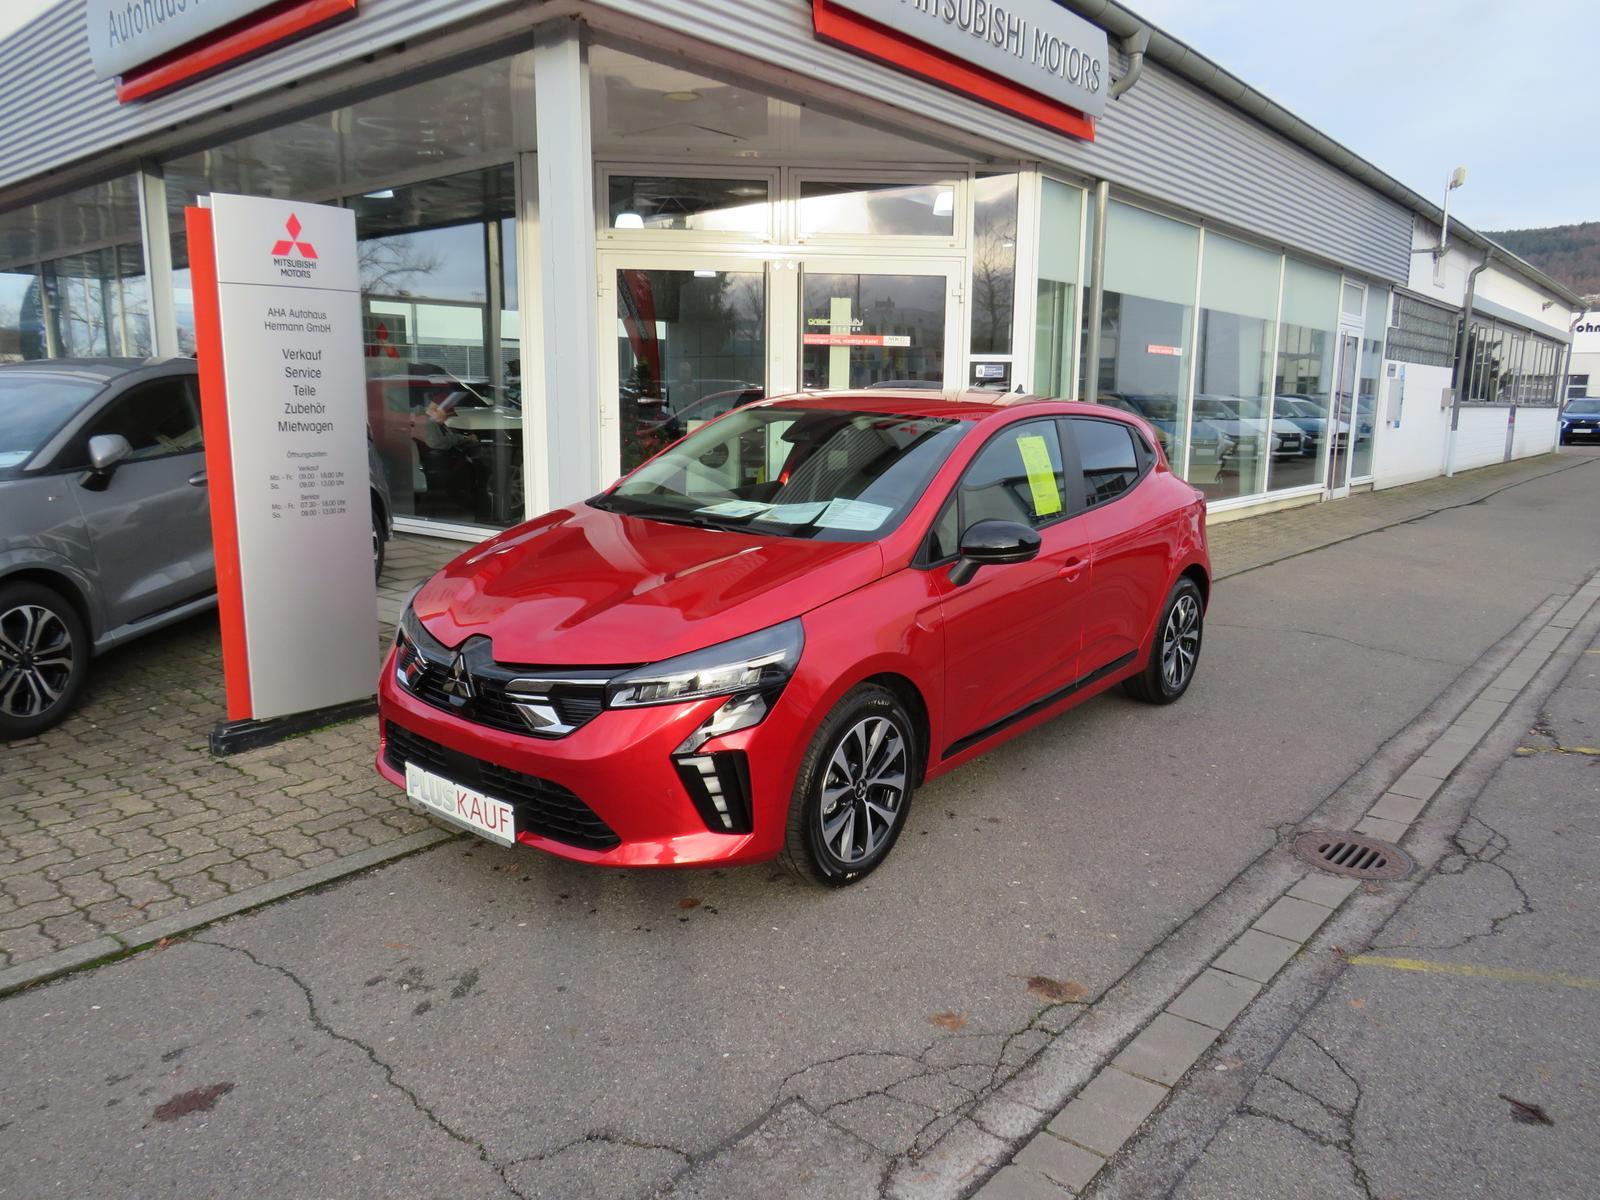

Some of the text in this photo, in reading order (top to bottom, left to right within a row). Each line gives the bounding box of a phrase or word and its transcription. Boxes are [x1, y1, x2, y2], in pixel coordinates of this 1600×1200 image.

[899, 0, 1101, 94] SUBISHI MOTORS
[273, 258, 317, 269] MITSUBISHI
[280, 268, 311, 279] MOTORS
[267, 307, 327, 320] AHA Autohaus
[264, 320, 332, 333] Hermann GmbH
[281, 348, 322, 361] Verkauf
[284, 366, 322, 379] Service
[293, 384, 316, 397] Teile
[284, 402, 326, 415] Zubehör
[277, 421, 334, 434] Mietwagen
